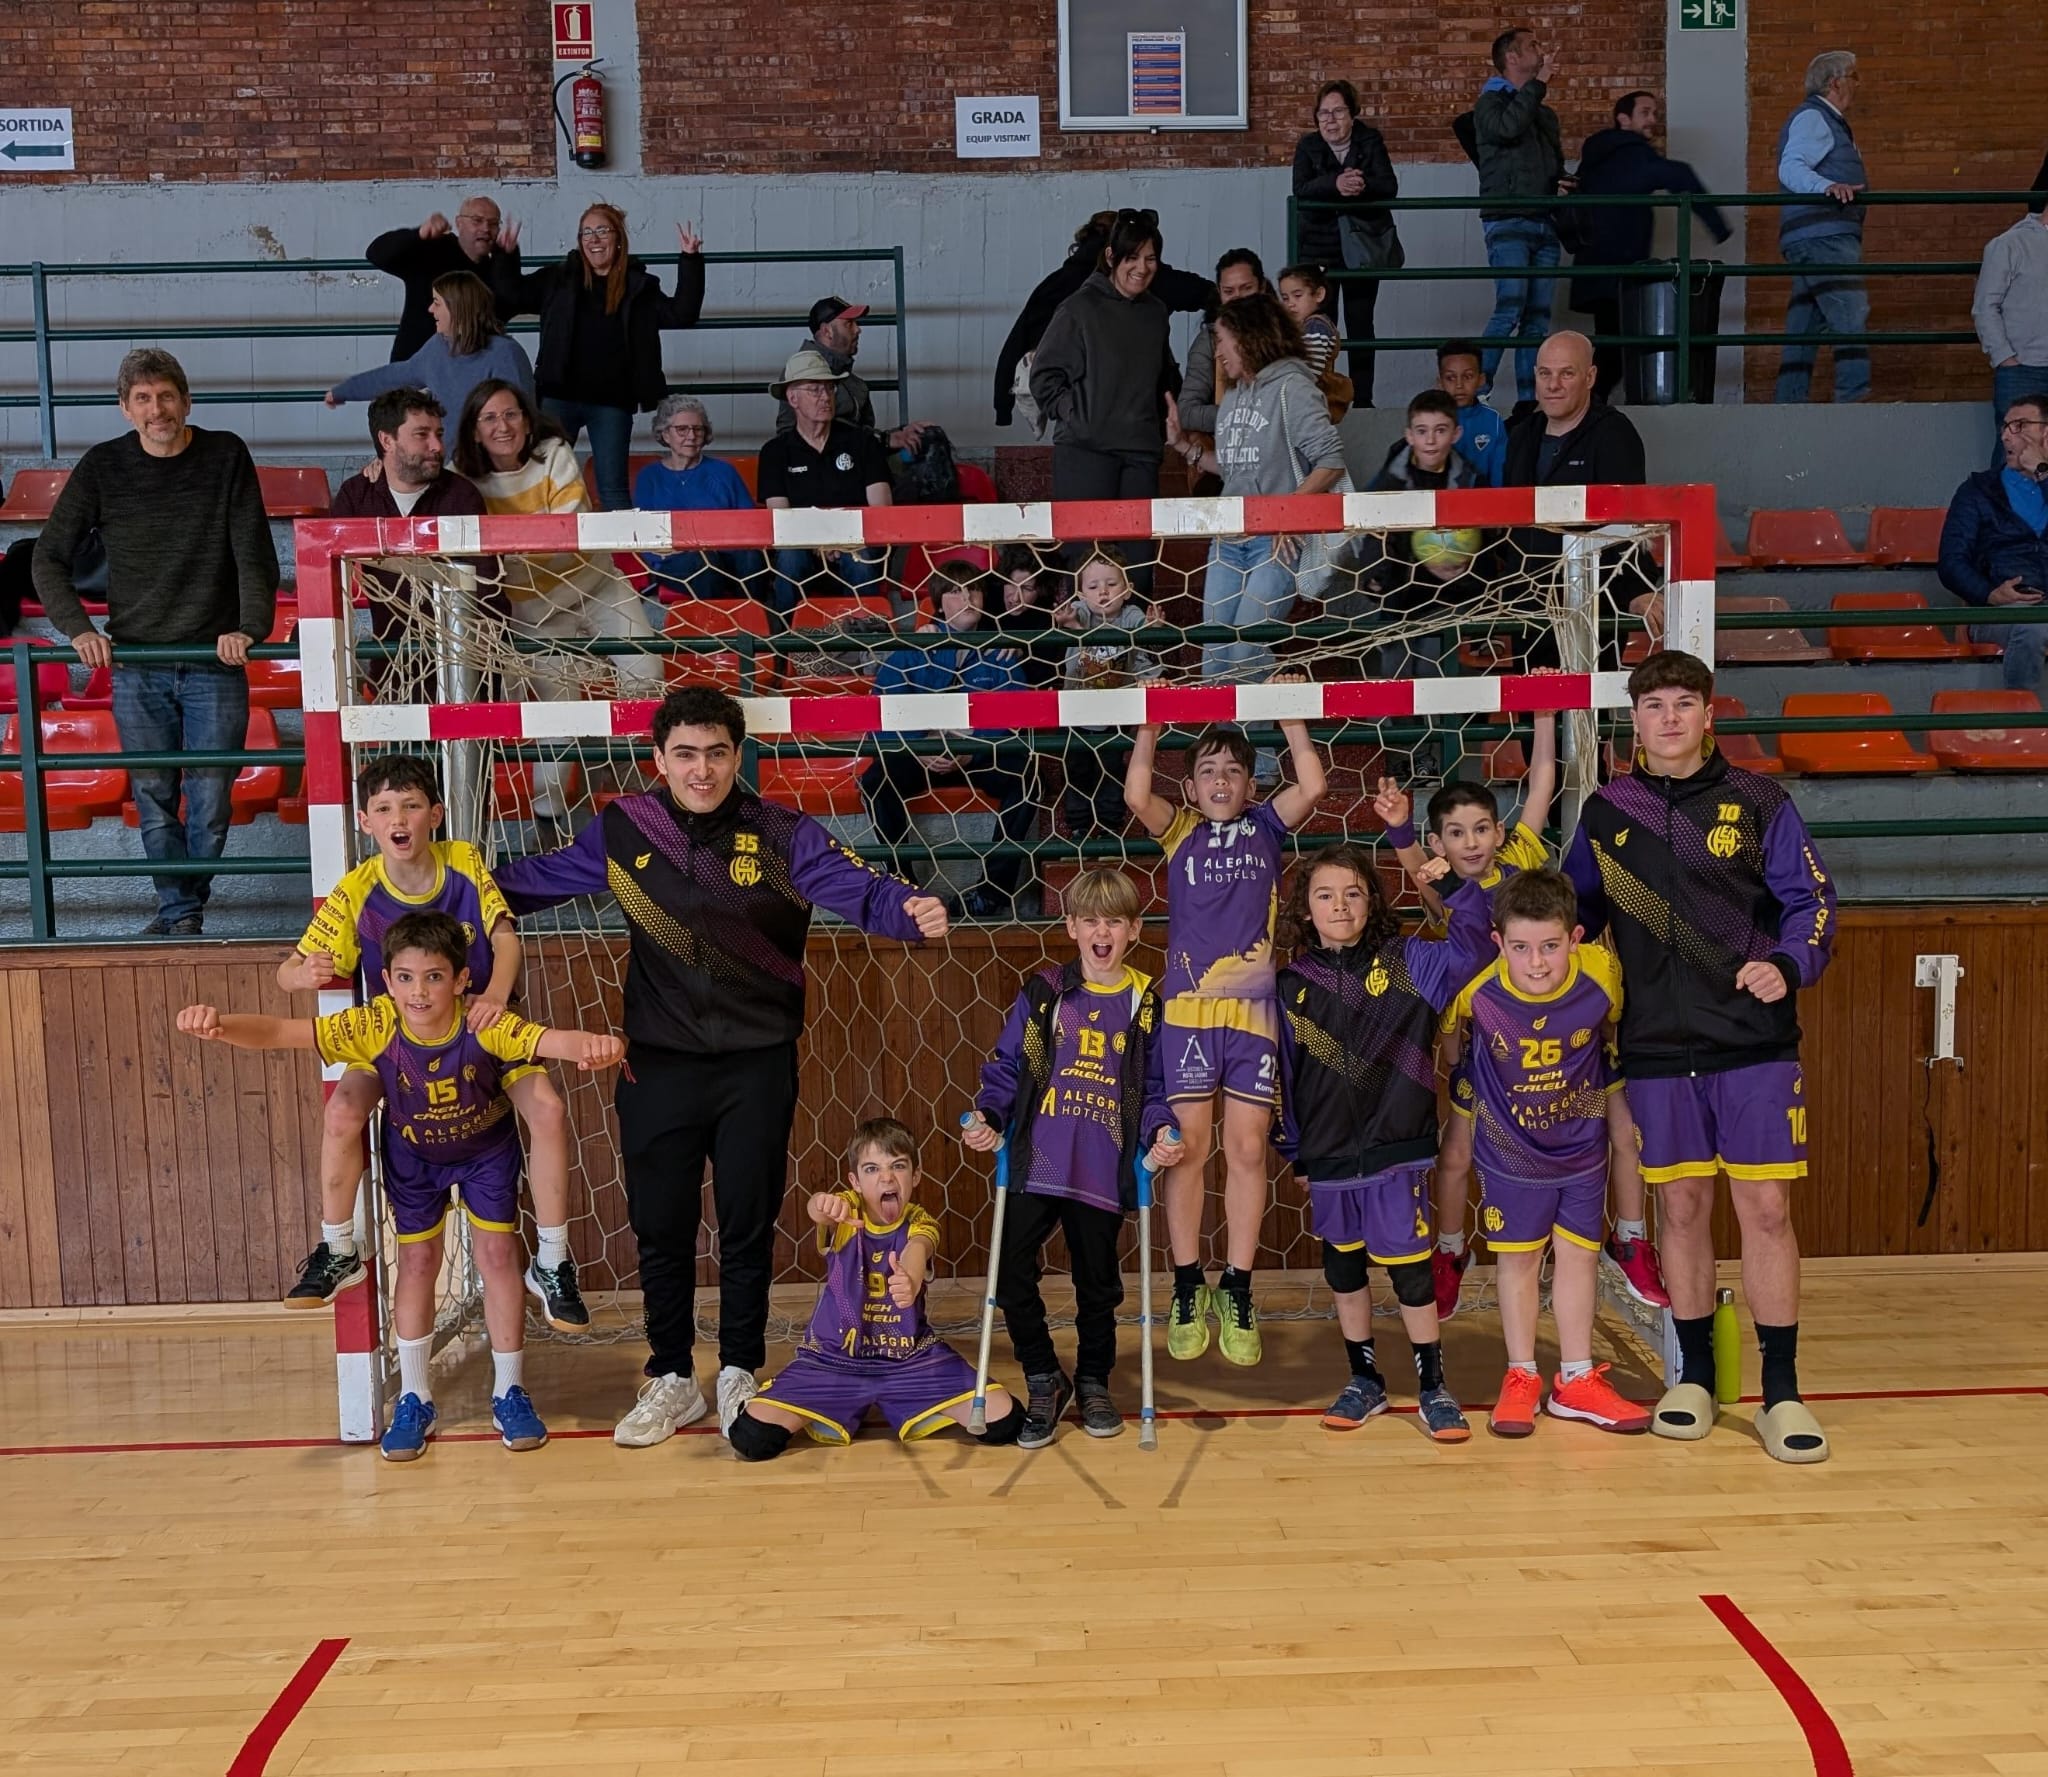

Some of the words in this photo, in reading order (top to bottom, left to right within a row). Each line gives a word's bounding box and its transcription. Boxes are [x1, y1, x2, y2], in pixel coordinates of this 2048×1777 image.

[0, 119, 64, 132] SORTIDA
[972, 111, 1025, 124] GRADA
[966, 135, 992, 144] EQUIP
[994, 134, 1031, 143] VISITANT
[1718, 804, 1742, 822] 10
[735, 833, 760, 852] 35
[1204, 870, 1257, 883] HOTELS
[308, 934, 343, 960] CALELLA
[1079, 1028, 1105, 1058] 13
[1519, 1038, 1562, 1069] 26
[1074, 1060, 1104, 1072] UEH
[1060, 1068, 1117, 1086] CALELLA
[1528, 1070, 1563, 1082] UEH
[425, 1078, 458, 1104] 15
[1512, 1080, 1568, 1092] CALELL
[1064, 1089, 1122, 1114] ALEGRI
[1062, 1105, 1117, 1127] HOTELS
[1786, 1106, 1807, 1145] 10
[426, 1128, 480, 1144] HOTEL
[868, 1272, 887, 1298] 9
[864, 1303, 893, 1312] UEH
[862, 1313, 902, 1323] ALELLA
[863, 1333, 916, 1348] ALEGRI
